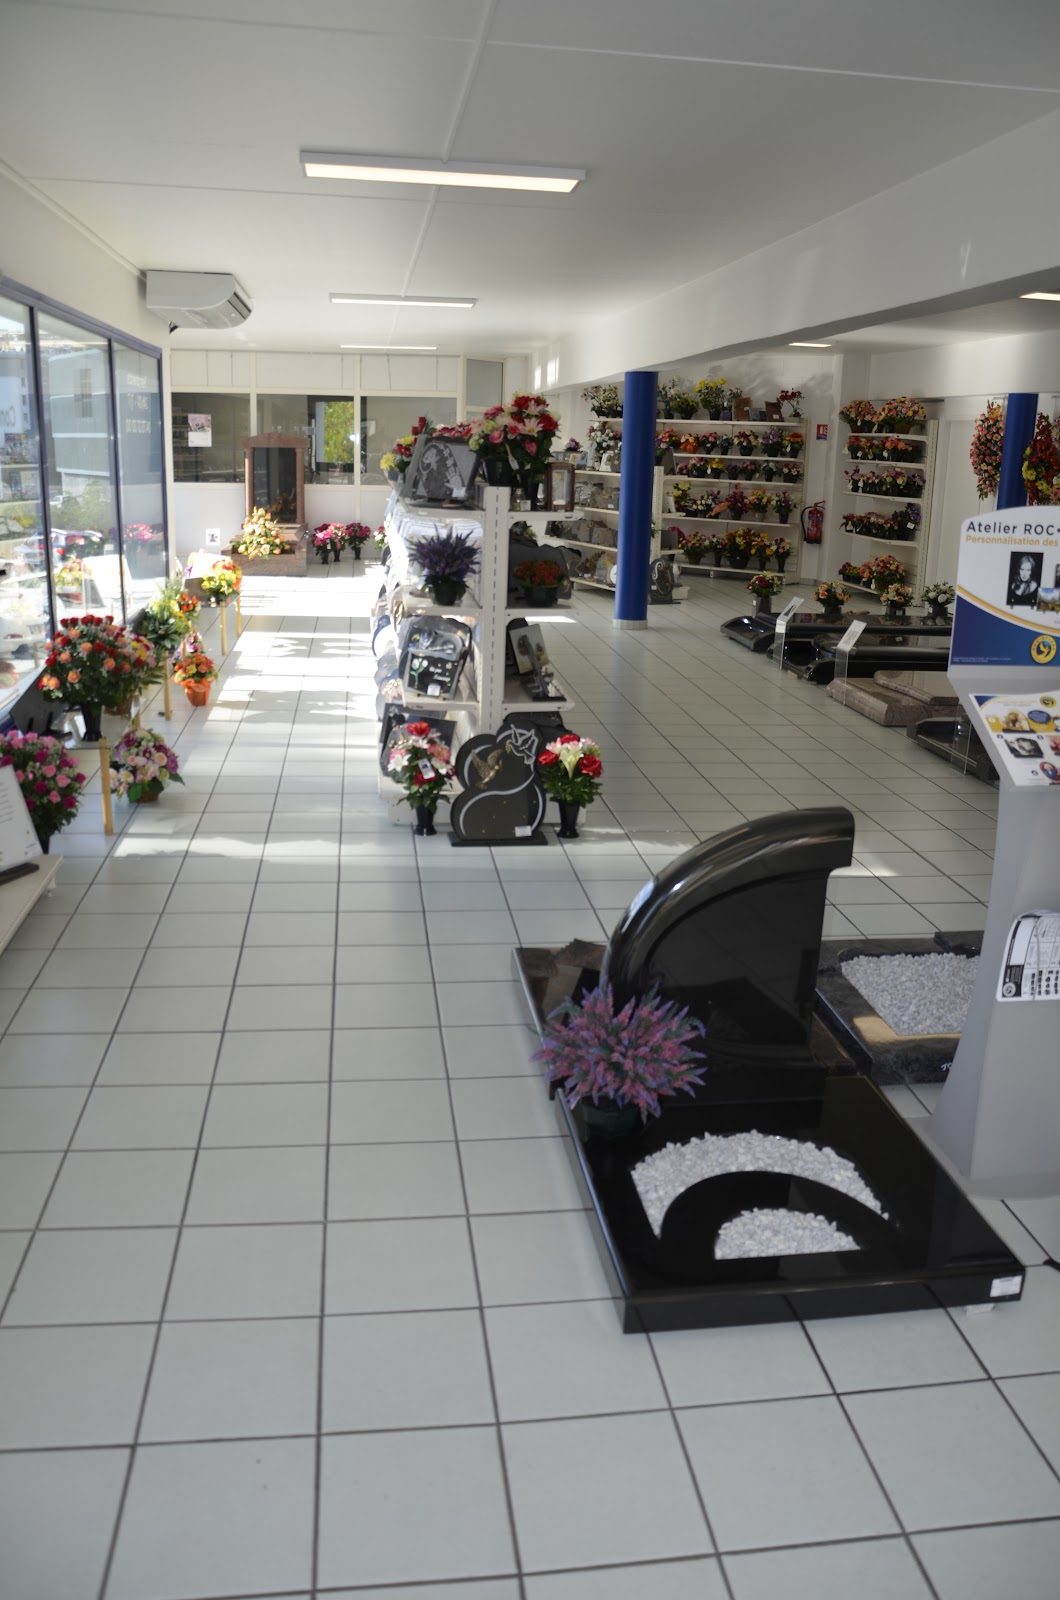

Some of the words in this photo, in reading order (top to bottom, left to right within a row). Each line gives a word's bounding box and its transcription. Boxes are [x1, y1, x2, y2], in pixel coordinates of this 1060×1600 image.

[966, 521, 1018, 535] Atelier
[965, 534, 1040, 546] Personnalisation
[1042, 538, 1058, 547] des
